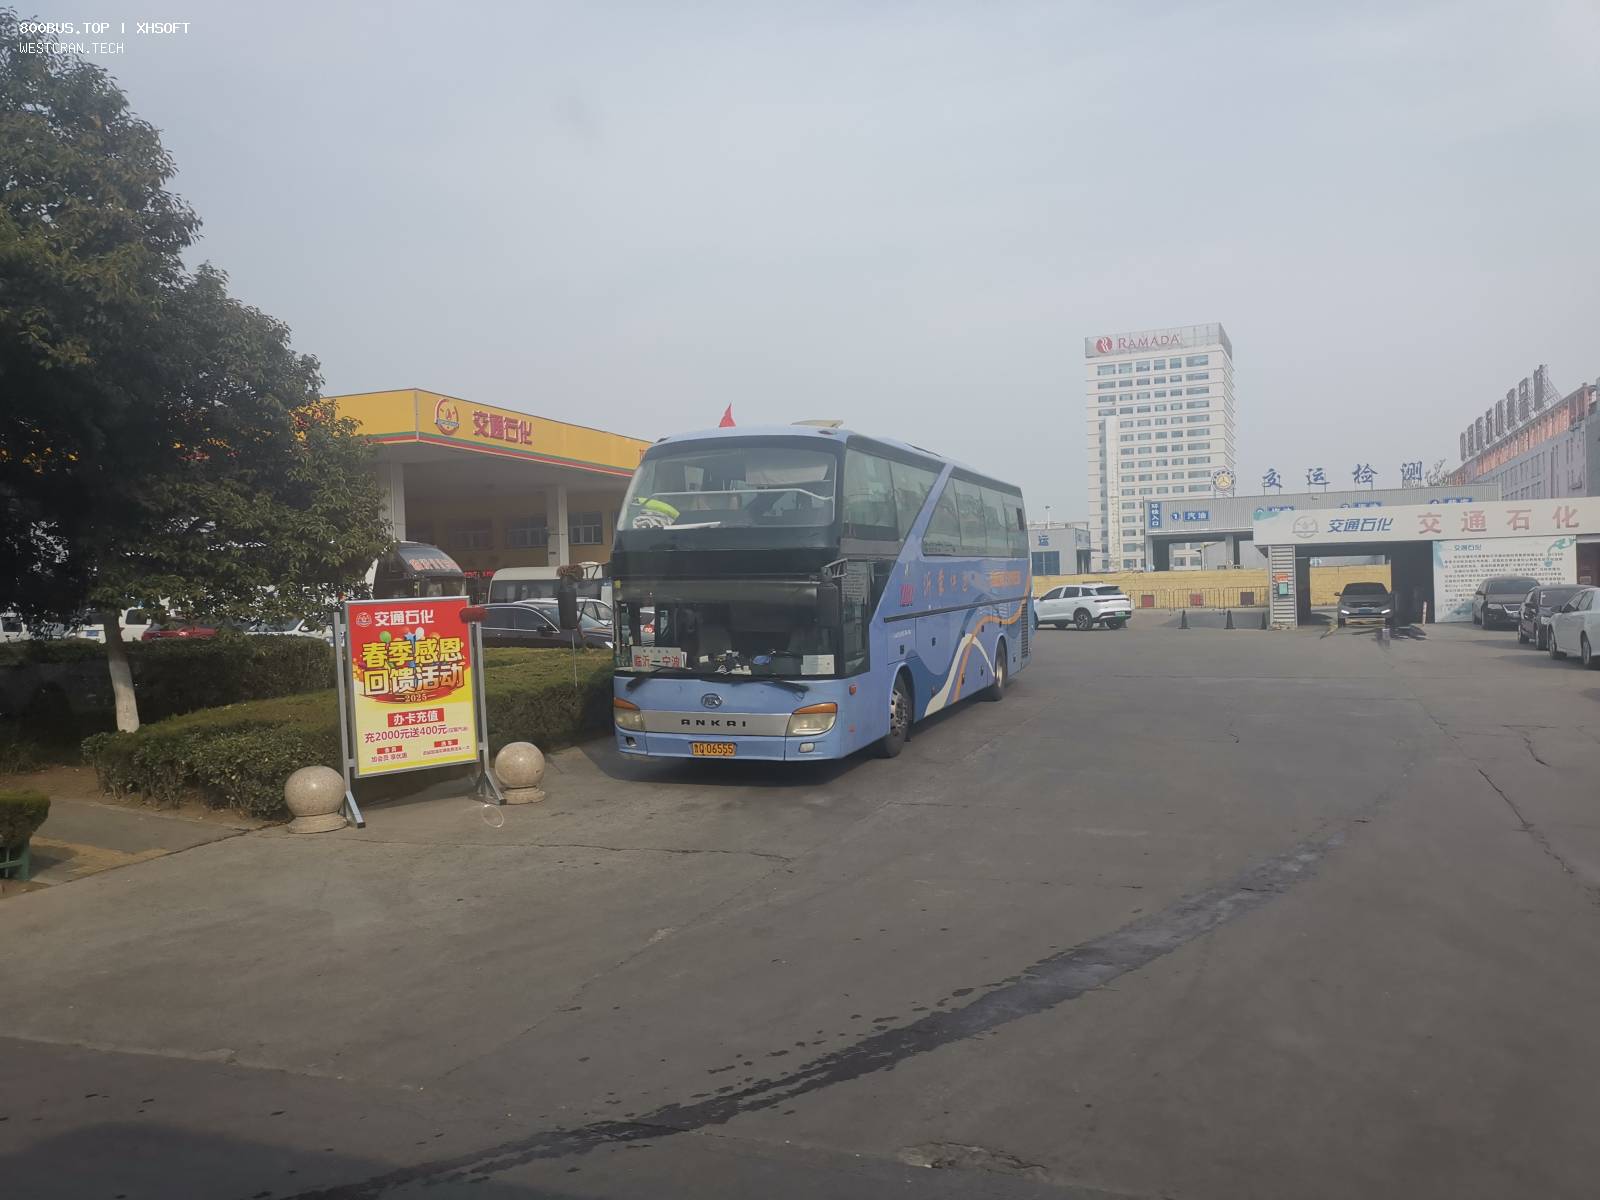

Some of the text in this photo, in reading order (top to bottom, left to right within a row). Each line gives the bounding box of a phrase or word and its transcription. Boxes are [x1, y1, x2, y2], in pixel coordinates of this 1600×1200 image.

[1118, 334, 1179, 349] RAMADA
[472, 410, 533, 445] 交通石化
[1262, 461, 1423, 488] 交运检测
[1327, 517, 1394, 534] 交通石化
[1417, 505, 1580, 535] 交通石化
[374, 609, 435, 627] 交通石化
[362, 637, 464, 669] 春季感恩
[363, 663, 465, 696] 回馈活动
[404, 693, 428, 703] 2025
[393, 710, 439, 727] 办卡充值
[681, 719, 747, 728] ANKAI
[364, 724, 448, 744] 充2000元送400元
